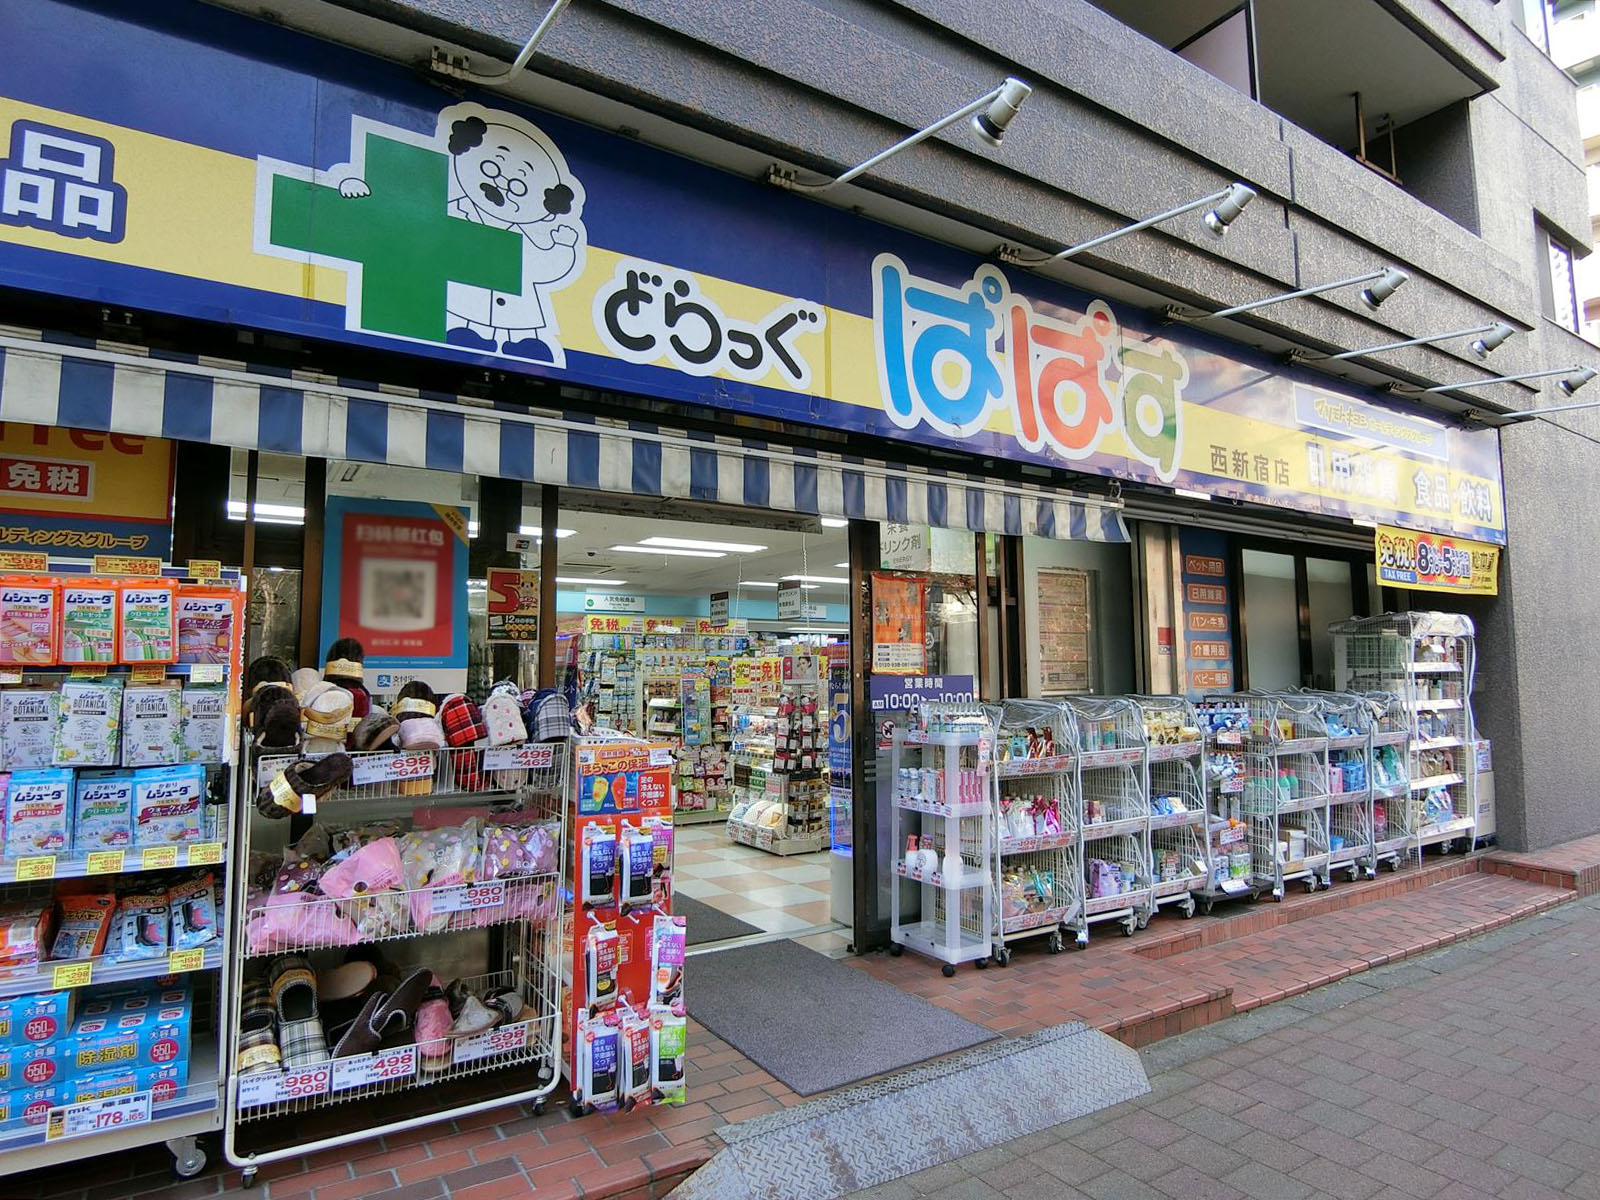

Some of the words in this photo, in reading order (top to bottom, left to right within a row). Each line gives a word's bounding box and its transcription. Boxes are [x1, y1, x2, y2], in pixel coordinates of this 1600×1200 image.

[3, 129, 114, 234] 品
[603, 268, 819, 381] どらっぐ
[878, 260, 1187, 478] ぱぱす
[1210, 444, 1290, 486] 西新宿店
[8, 462, 80, 493] 免税
[1383, 568, 1398, 579] TAX
[1398, 570, 1413, 582] FREE
[2, 592, 52, 604] ムシューダ
[125, 593, 171, 604] ムシューダ
[488, 571, 521, 613] 5
[1192, 588, 1223, 601] 日用雑貨
[66, 593, 115, 605] ムシューダ
[184, 602, 226, 612] ムシューダ
[590, 617, 619, 631] 免税
[1194, 645, 1226, 656] 介護用品
[904, 677, 943, 689] 営業時間
[1195, 673, 1228, 684] ベビー用品
[73, 699, 107, 710] BOTANICAL
[884, 693, 920, 709] 10:00
[13, 704, 49, 715] BOTANICAL
[136, 703, 169, 713] BOTANICAL
[193, 704, 223, 714] BOTANICAL
[518, 750, 551, 760] 498
[392, 756, 430, 769] 698
[523, 759, 550, 767] 462
[581, 757, 669, 776] ほら、この保温
[399, 766, 430, 777] 647
[83, 788, 130, 801] ムシューダ
[146, 786, 191, 799] ムシューダ
[641, 783, 665, 793] 冷えない
[14, 789, 65, 802] ムシューダ
[467, 887, 502, 899] 980
[472, 896, 500, 906] 908
[24, 1005, 57, 1016] 大容量
[27, 1019, 48, 1034] 550
[149, 1028, 179, 1040] 大容量
[490, 1029, 525, 1044] 598
[153, 1043, 171, 1055] 550
[495, 1038, 523, 1051] 554
[24, 1047, 57, 1058] 大容量
[77, 1042, 137, 1067] 除湿剤
[374, 1054, 413, 1070] 498
[26, 1062, 47, 1077] 550
[149, 1068, 178, 1081] 大容量
[380, 1064, 410, 1078] 462
[285, 1072, 328, 1088] 980
[23, 1088, 56, 1100] 大容量
[291, 1082, 326, 1097] 908
[96, 1111, 123, 1129] 178
[128, 1111, 146, 1122] 165
